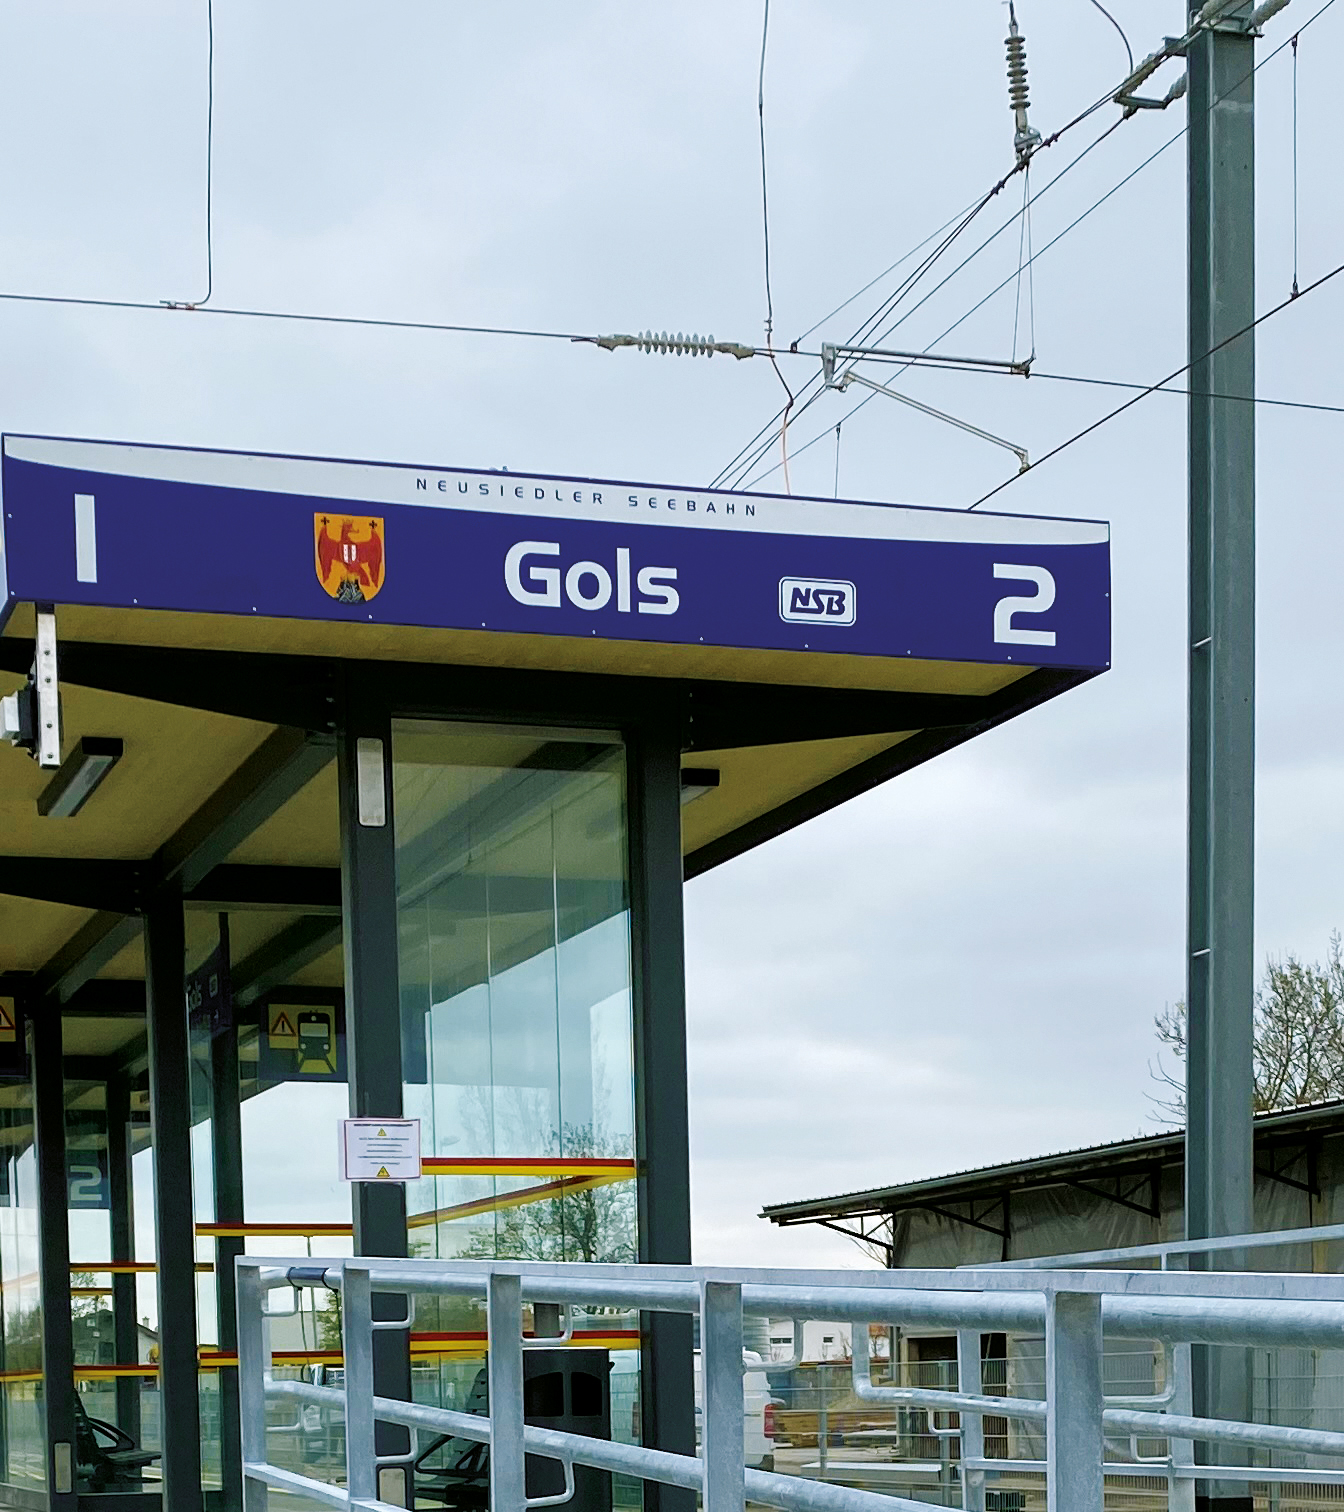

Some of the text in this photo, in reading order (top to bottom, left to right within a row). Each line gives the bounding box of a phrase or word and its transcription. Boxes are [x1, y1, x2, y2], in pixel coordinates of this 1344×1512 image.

[416, 477, 756, 517] NEUSIEDLER SEEBAHN
[505, 540, 680, 616] Gols
[789, 587, 846, 616] NSB
[992, 562, 1056, 647] 2
[69, 1165, 103, 1201] 2
